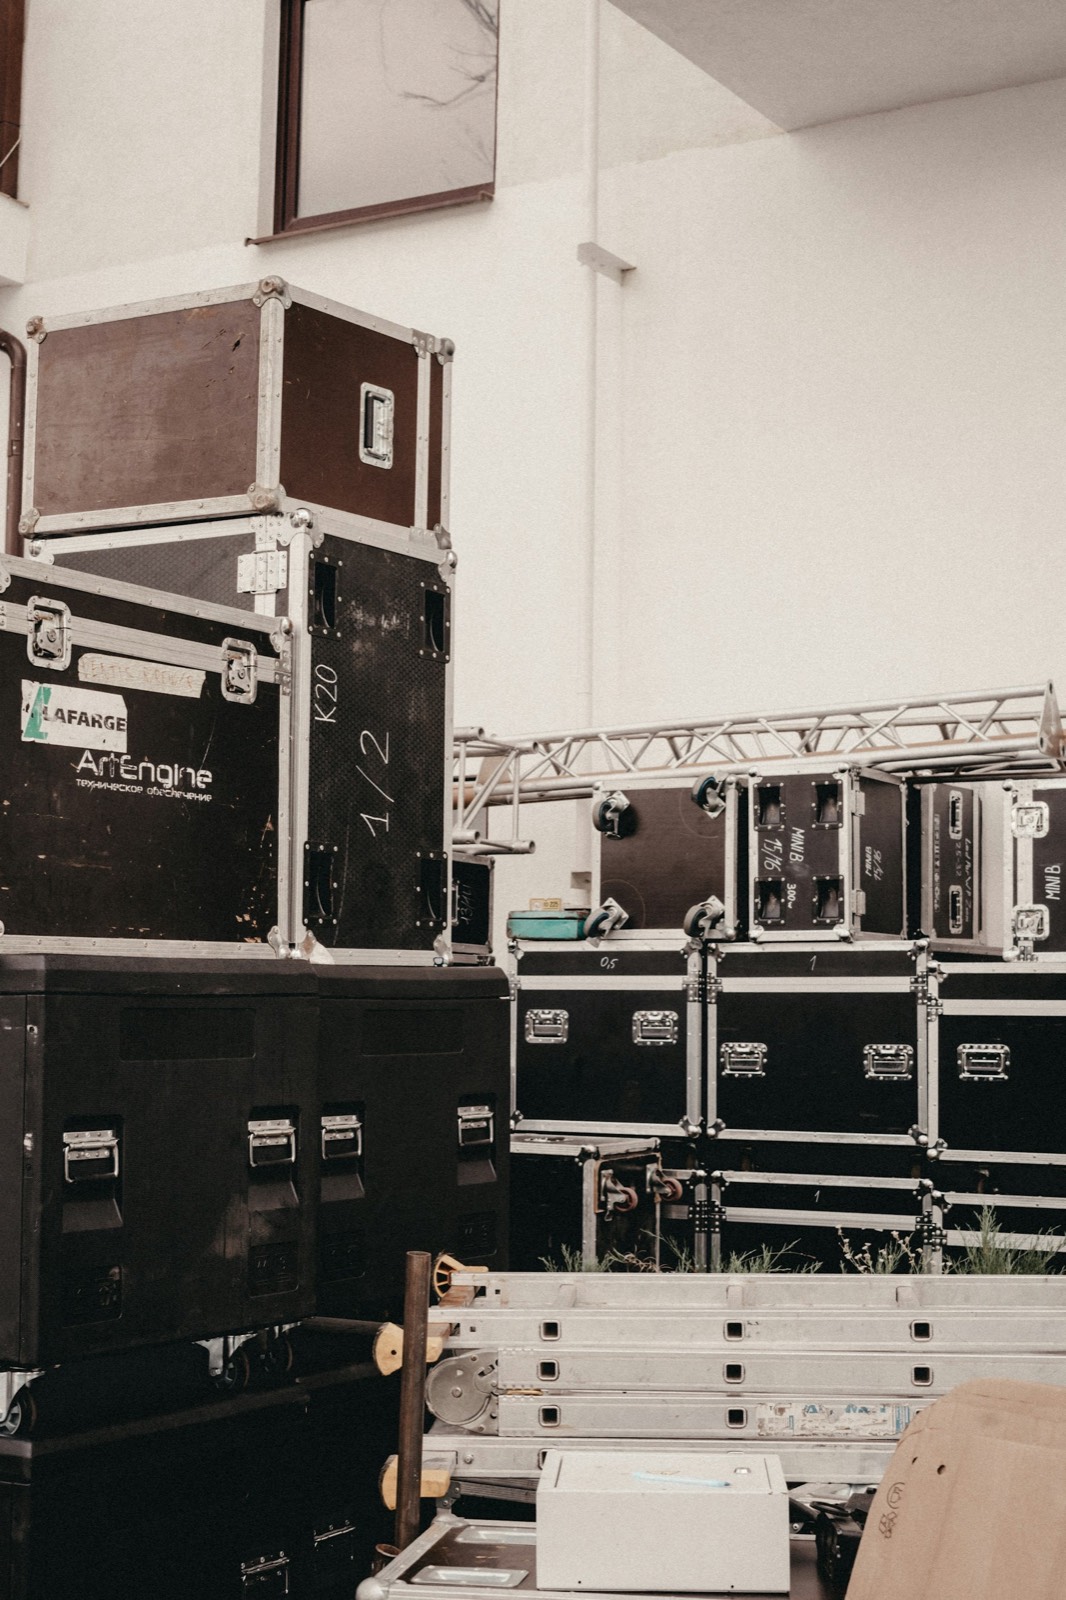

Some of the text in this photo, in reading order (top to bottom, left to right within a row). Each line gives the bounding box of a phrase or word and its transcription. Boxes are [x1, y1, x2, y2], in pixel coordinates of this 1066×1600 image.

[314, 663, 338, 724] K20
[42, 706, 127, 732] LAFARGE
[76, 749, 213, 789] ArtEngine
[356, 729, 395, 837] 1/2
[760, 838, 783, 872] 15/16
[1044, 875, 1061, 901] MINI
[809, 955, 817, 971] 1
